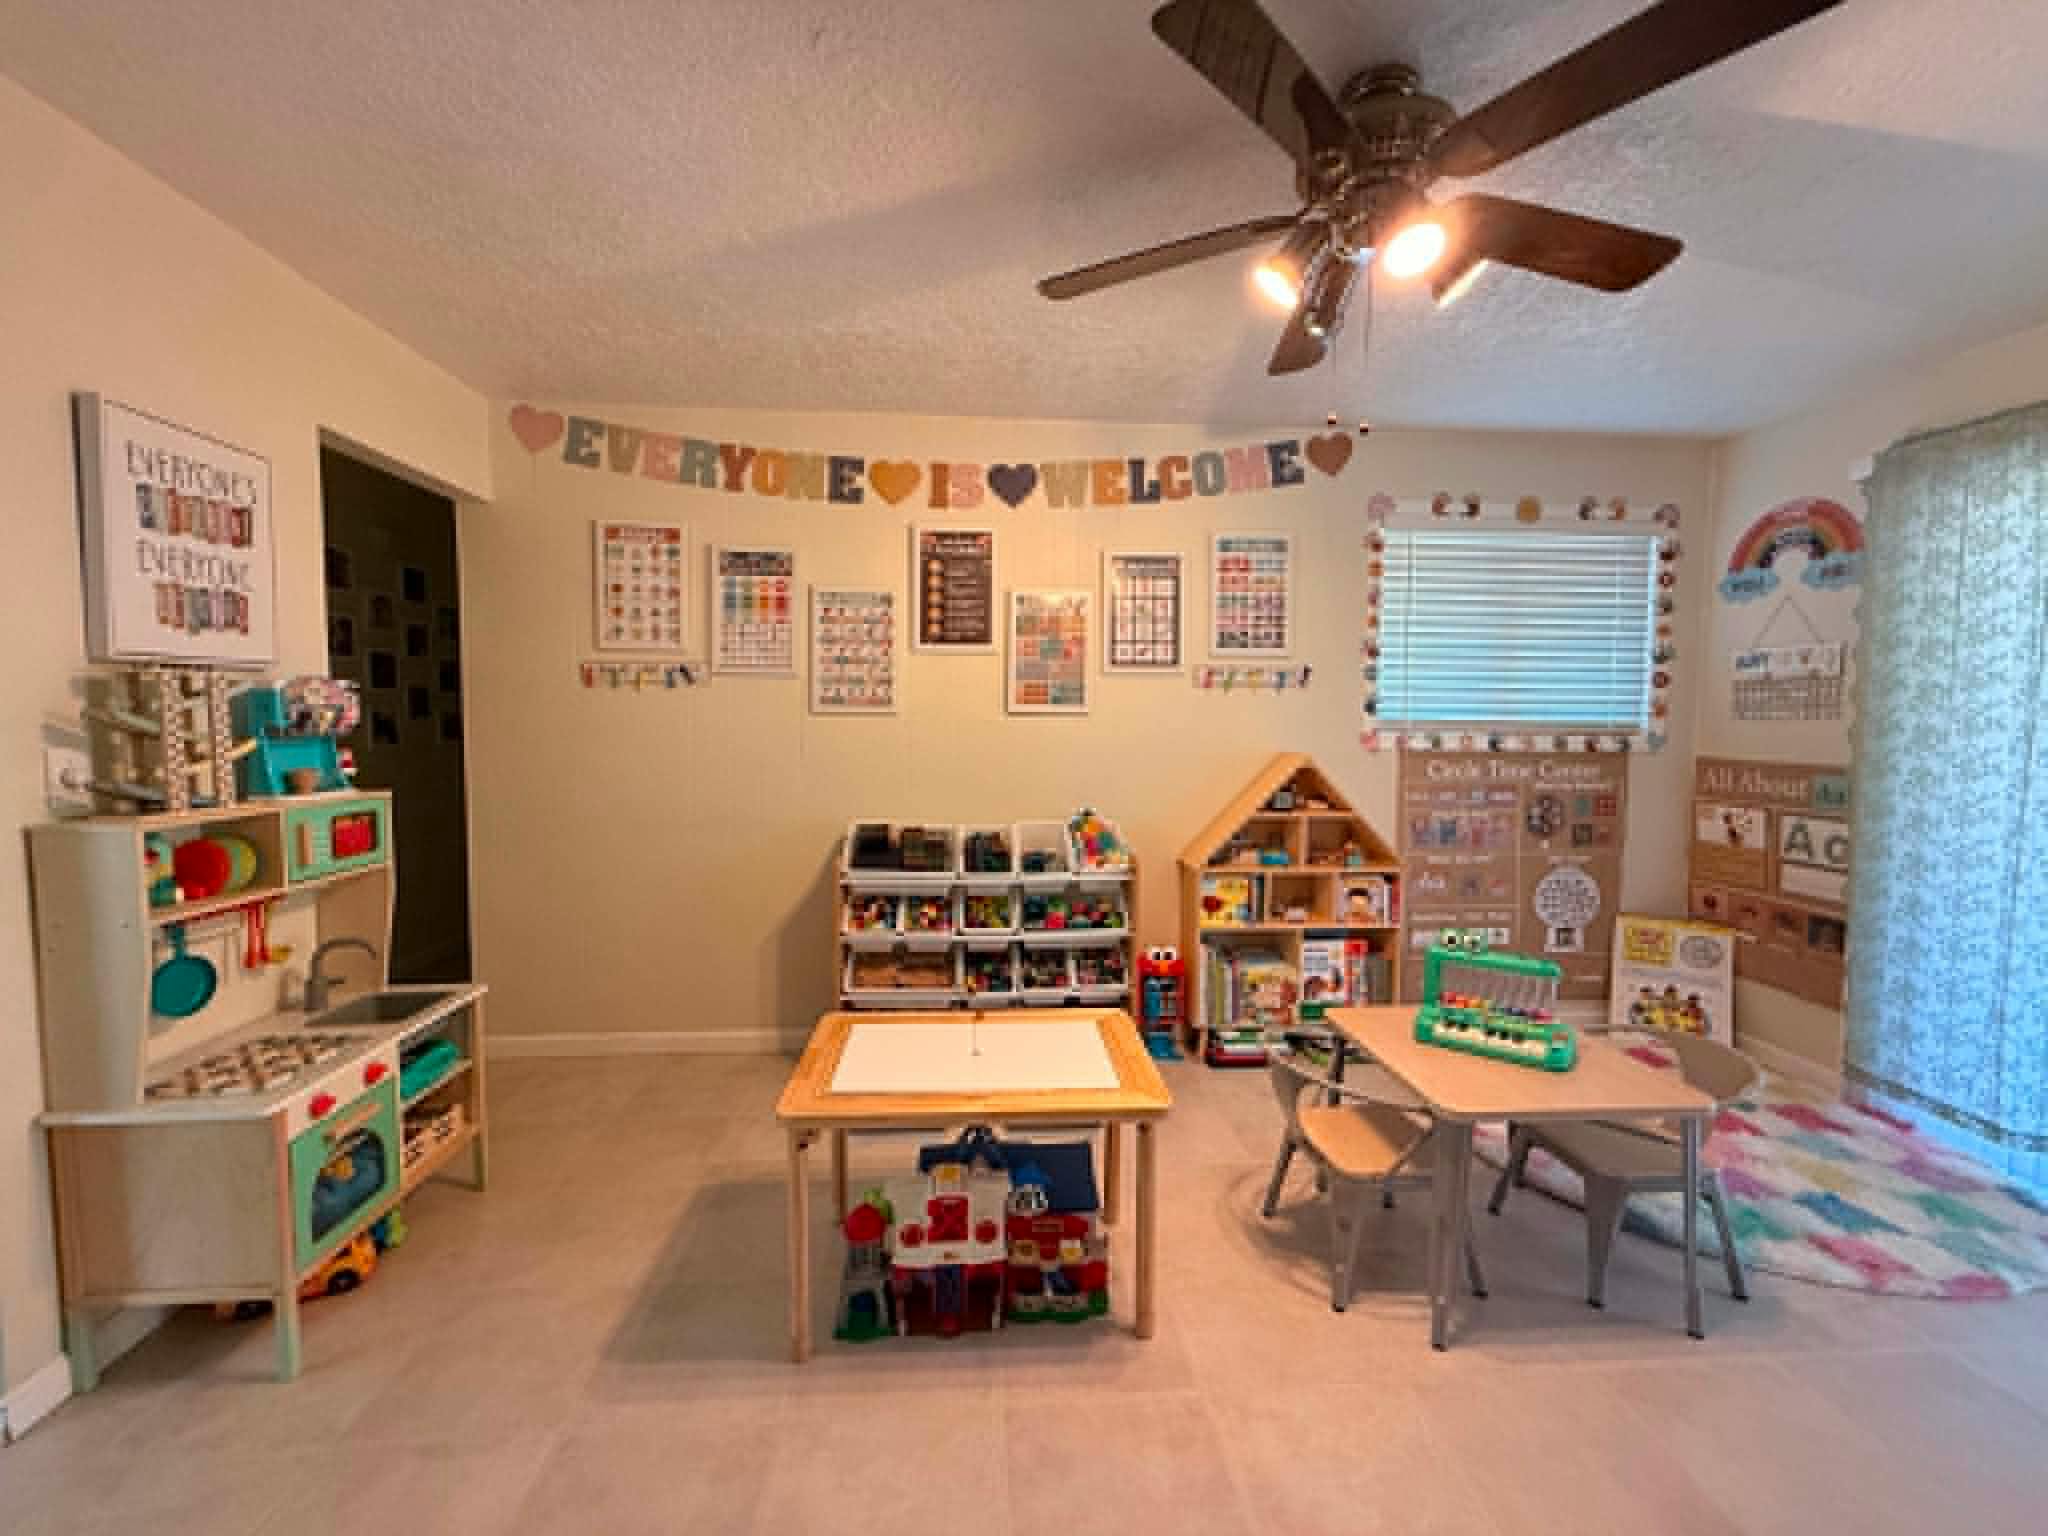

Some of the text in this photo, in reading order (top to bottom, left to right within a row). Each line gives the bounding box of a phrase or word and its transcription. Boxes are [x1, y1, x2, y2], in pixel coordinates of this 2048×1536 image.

[563, 415, 1305, 509] EVERYONE IS WELCOME
[1426, 760, 1482, 781] Circle
[1704, 767, 1734, 792] All
[1740, 770, 1809, 799] About
